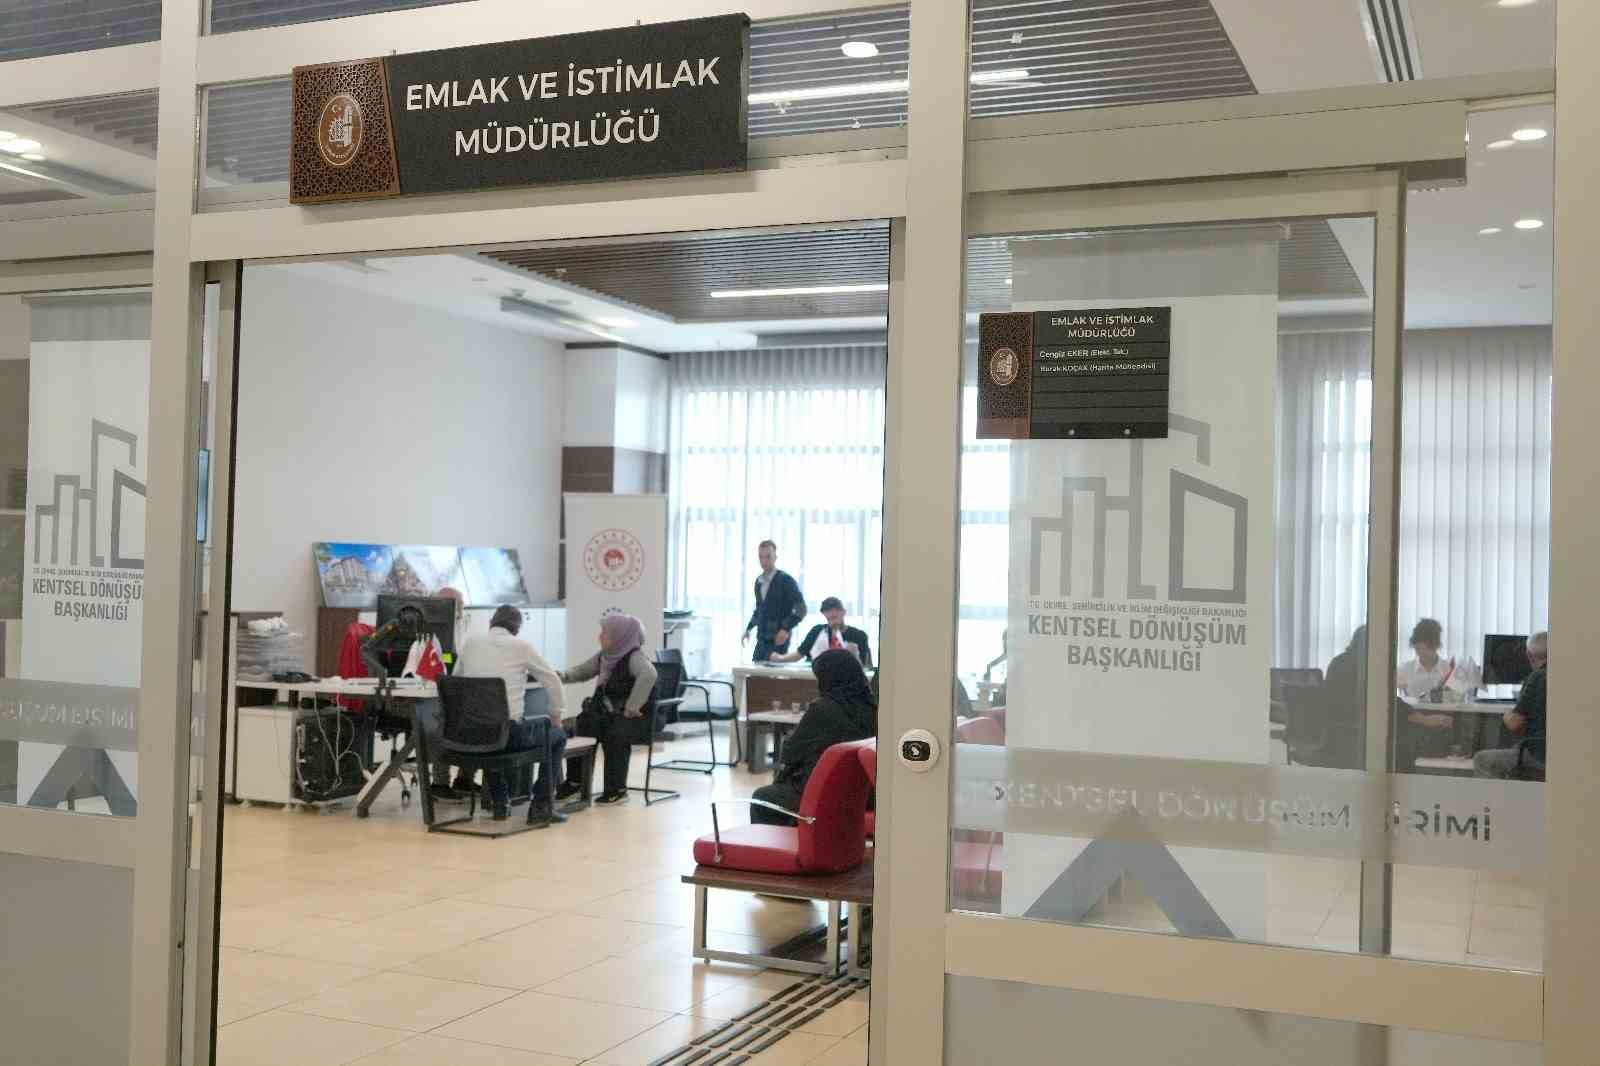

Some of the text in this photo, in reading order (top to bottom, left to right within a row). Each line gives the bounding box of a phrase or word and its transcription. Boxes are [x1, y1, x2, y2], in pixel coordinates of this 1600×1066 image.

[406, 56, 721, 111] EMLAK VE İSTİMLAK
[454, 108, 661, 157] MÜDÜRLÜĞÜ
[1051, 312, 1153, 326] EMLAK VE İSTİMLAK
[1067, 328, 1135, 338] MÜDÜRLÜĞÜ
[1067, 349, 1089, 357] EKER
[33, 578, 143, 604] KENTSEL DÖNÜŞÜ
[54, 600, 128, 622] BAŞKANLIĞI
[1028, 614, 1246, 648] KENTSEL DÖNÜŞÜM
[1067, 644, 1201, 672] BAŞKANLIĞI
